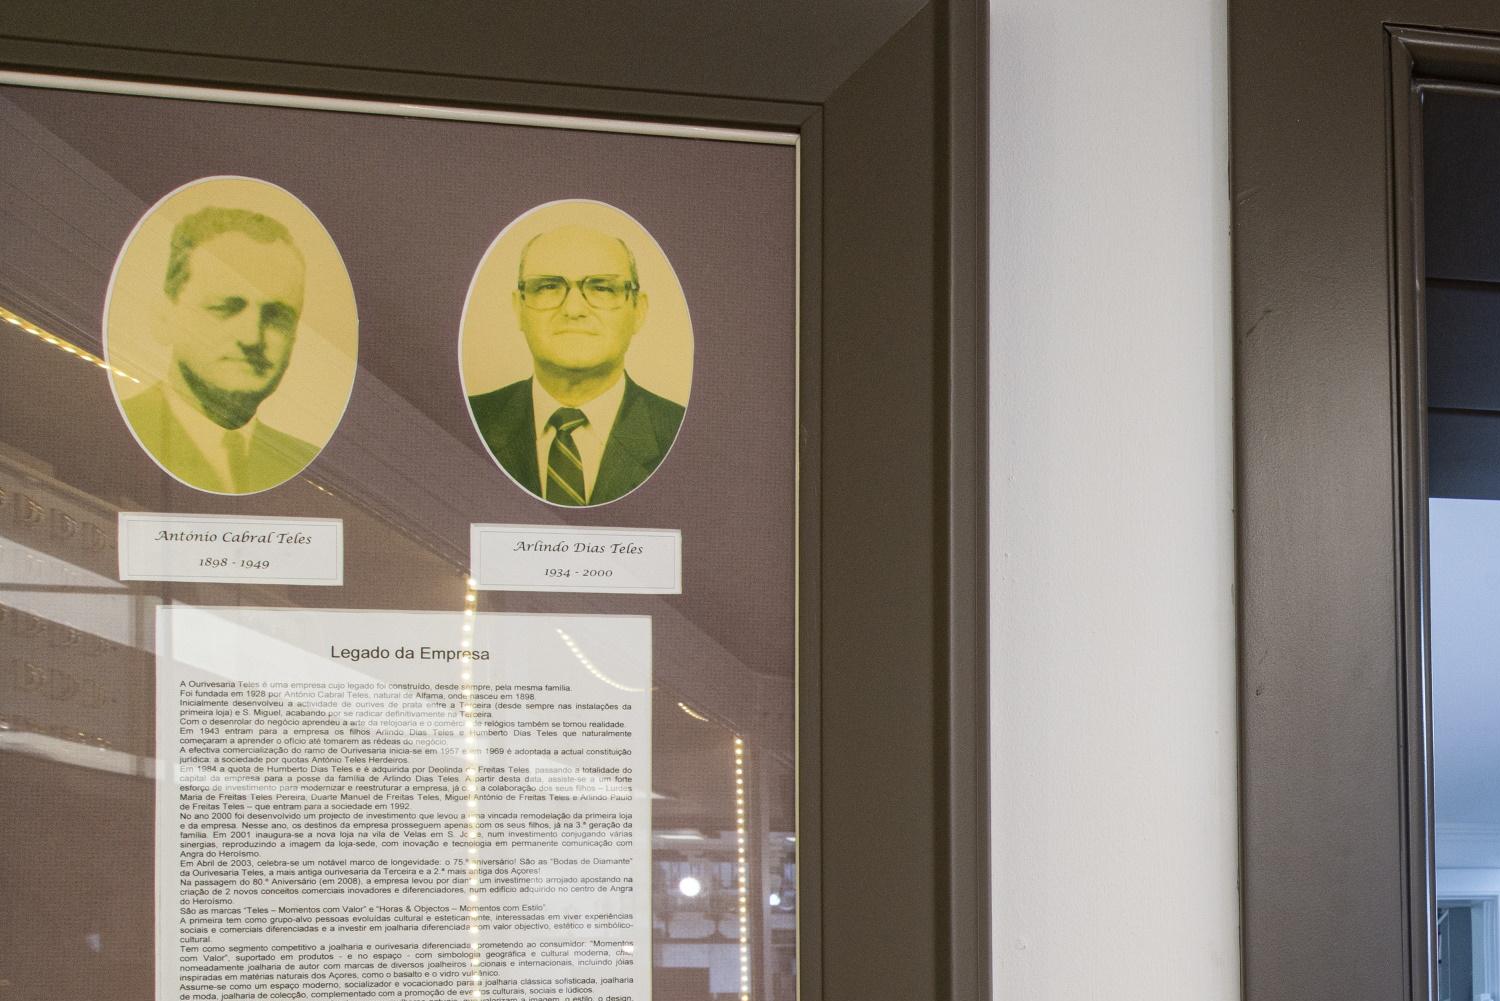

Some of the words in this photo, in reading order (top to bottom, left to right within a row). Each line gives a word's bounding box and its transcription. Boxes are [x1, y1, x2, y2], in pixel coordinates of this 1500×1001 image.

[155, 530, 217, 542] António
[222, 531, 273, 544] Cabral
[276, 532, 312, 545] Teles
[513, 540, 569, 553] Arlindo
[573, 542, 605, 554] Dias
[610, 542, 644, 555] Teles
[199, 557, 228, 568] 1898
[240, 559, 270, 570] 1949
[544, 567, 571, 578] 1934
[583, 568, 613, 577] 2000
[331, 645, 390, 662] Legado
[394, 646, 415, 660] da
[420, 646, 490, 662] Empresa
[237, 736, 274, 745] aprender
[281, 755, 309, 764] quotas
[180, 850, 204, 858] Angra
[297, 868, 322, 876] antiga
[468, 867, 492, 875] antiga
[413, 904, 450, 913] Objectos
[180, 973, 222, 982] inspiradas
